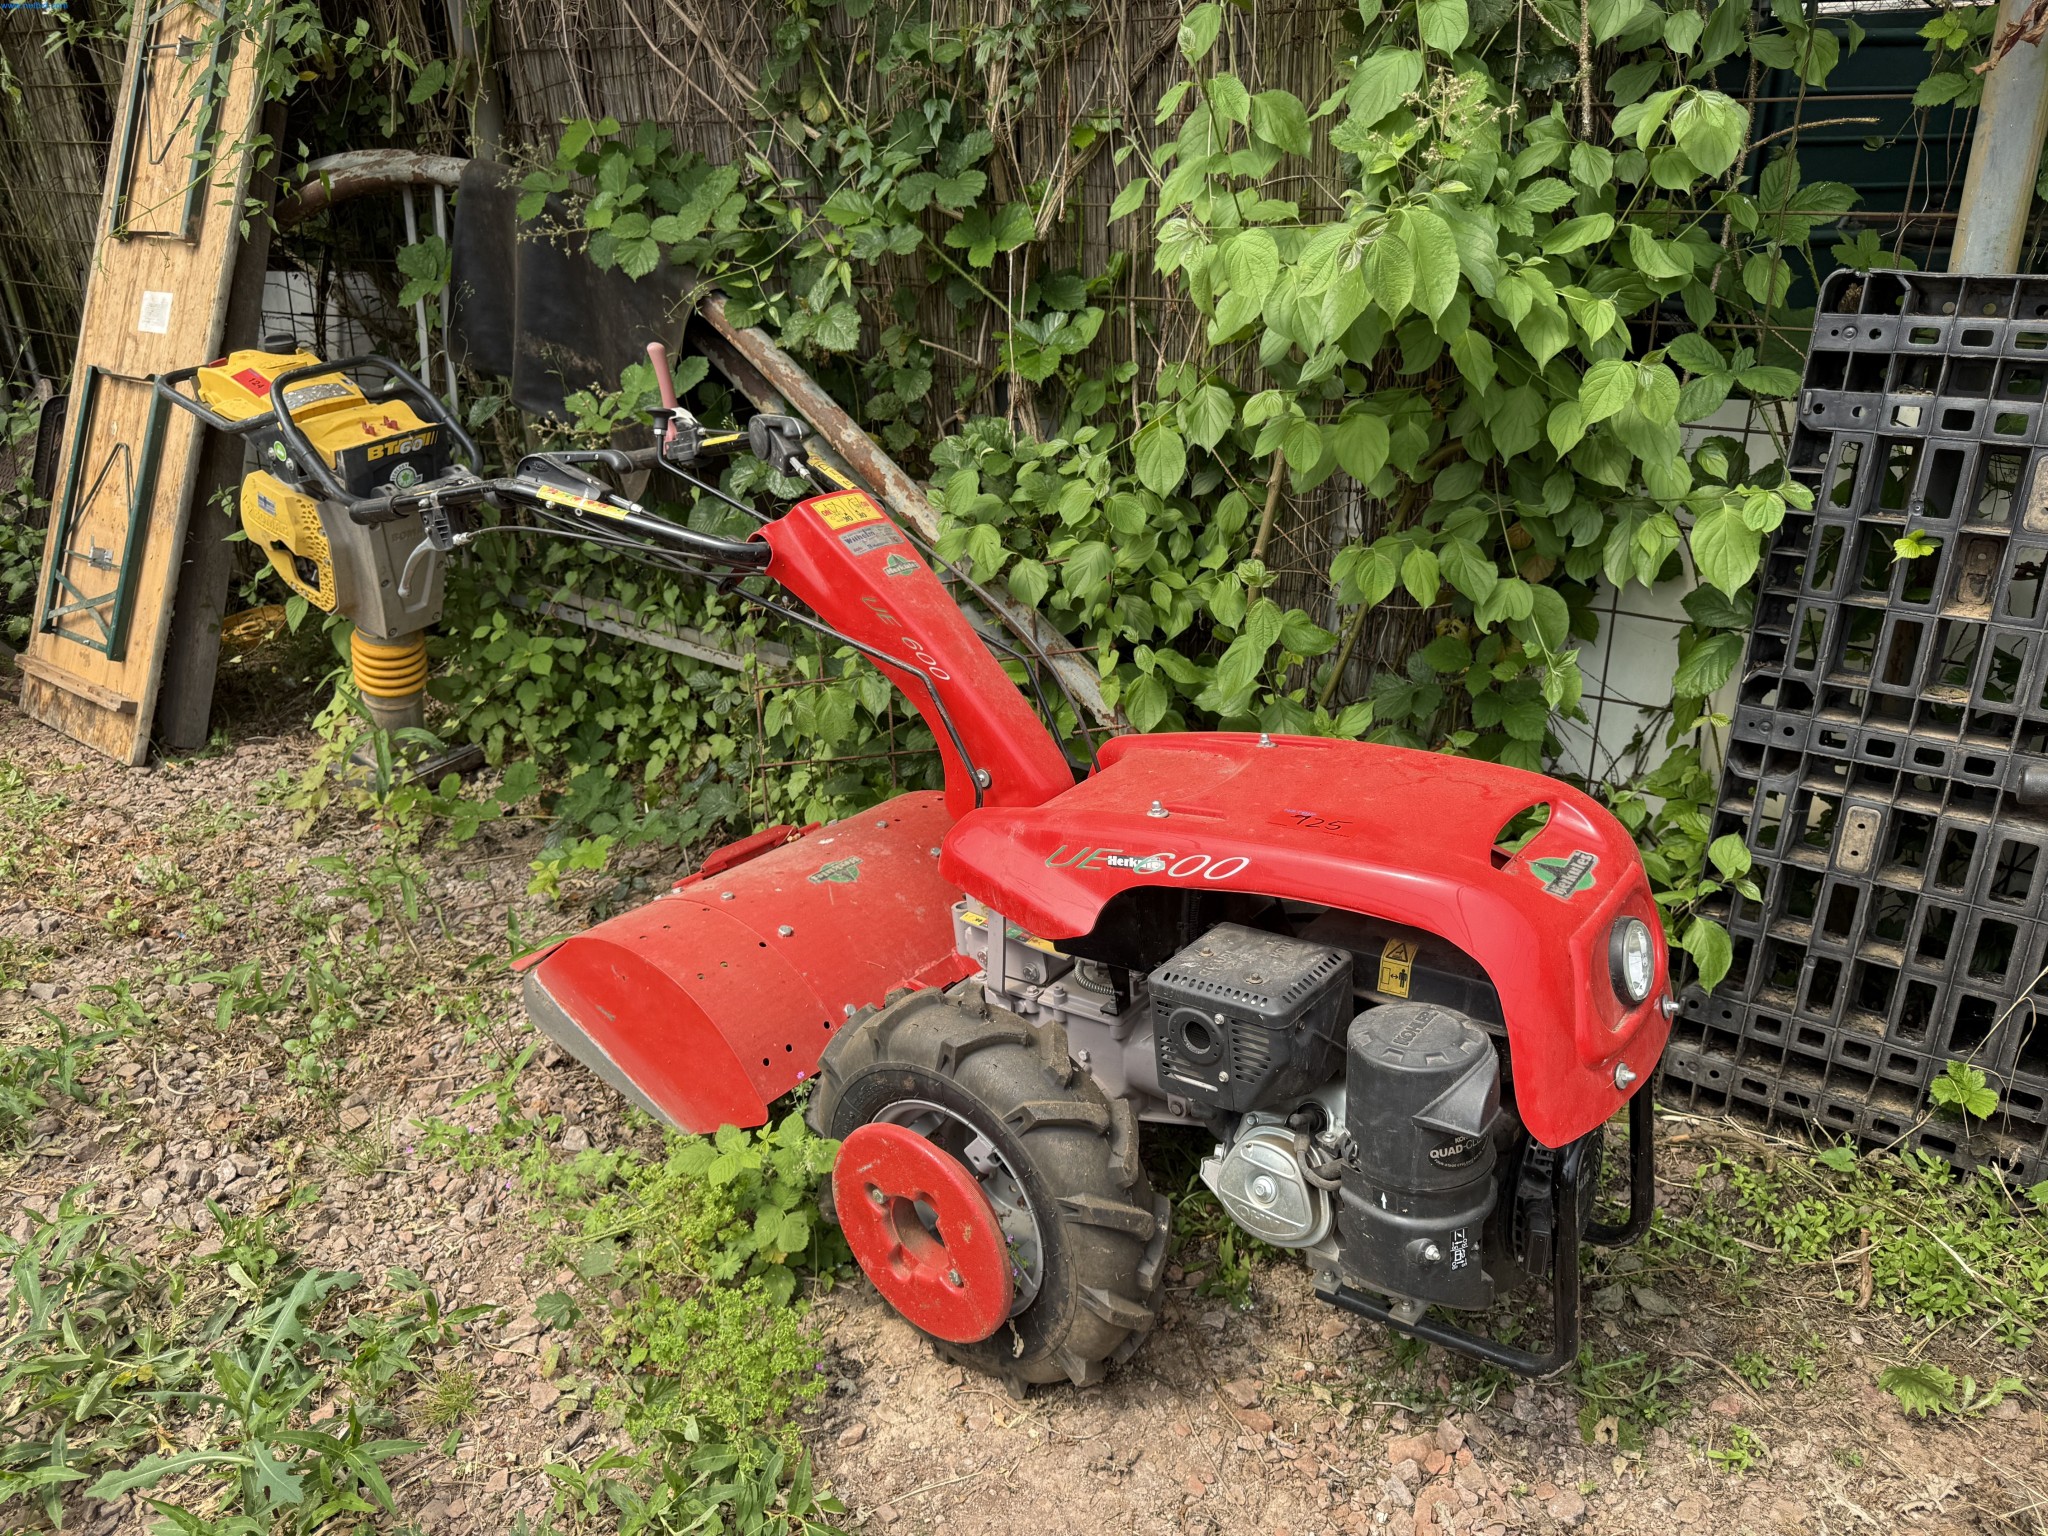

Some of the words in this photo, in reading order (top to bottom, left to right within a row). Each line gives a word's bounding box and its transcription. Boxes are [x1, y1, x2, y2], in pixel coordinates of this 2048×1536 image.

[248, 377, 265, 389] 124
[862, 597, 902, 628] UE
[901, 637, 950, 681] 600
[1045, 845, 1124, 871] UE
[1133, 852, 1250, 880] 600
[1550, 853, 1592, 894] Herkules
[1391, 1010, 1440, 1047] KOHLER
